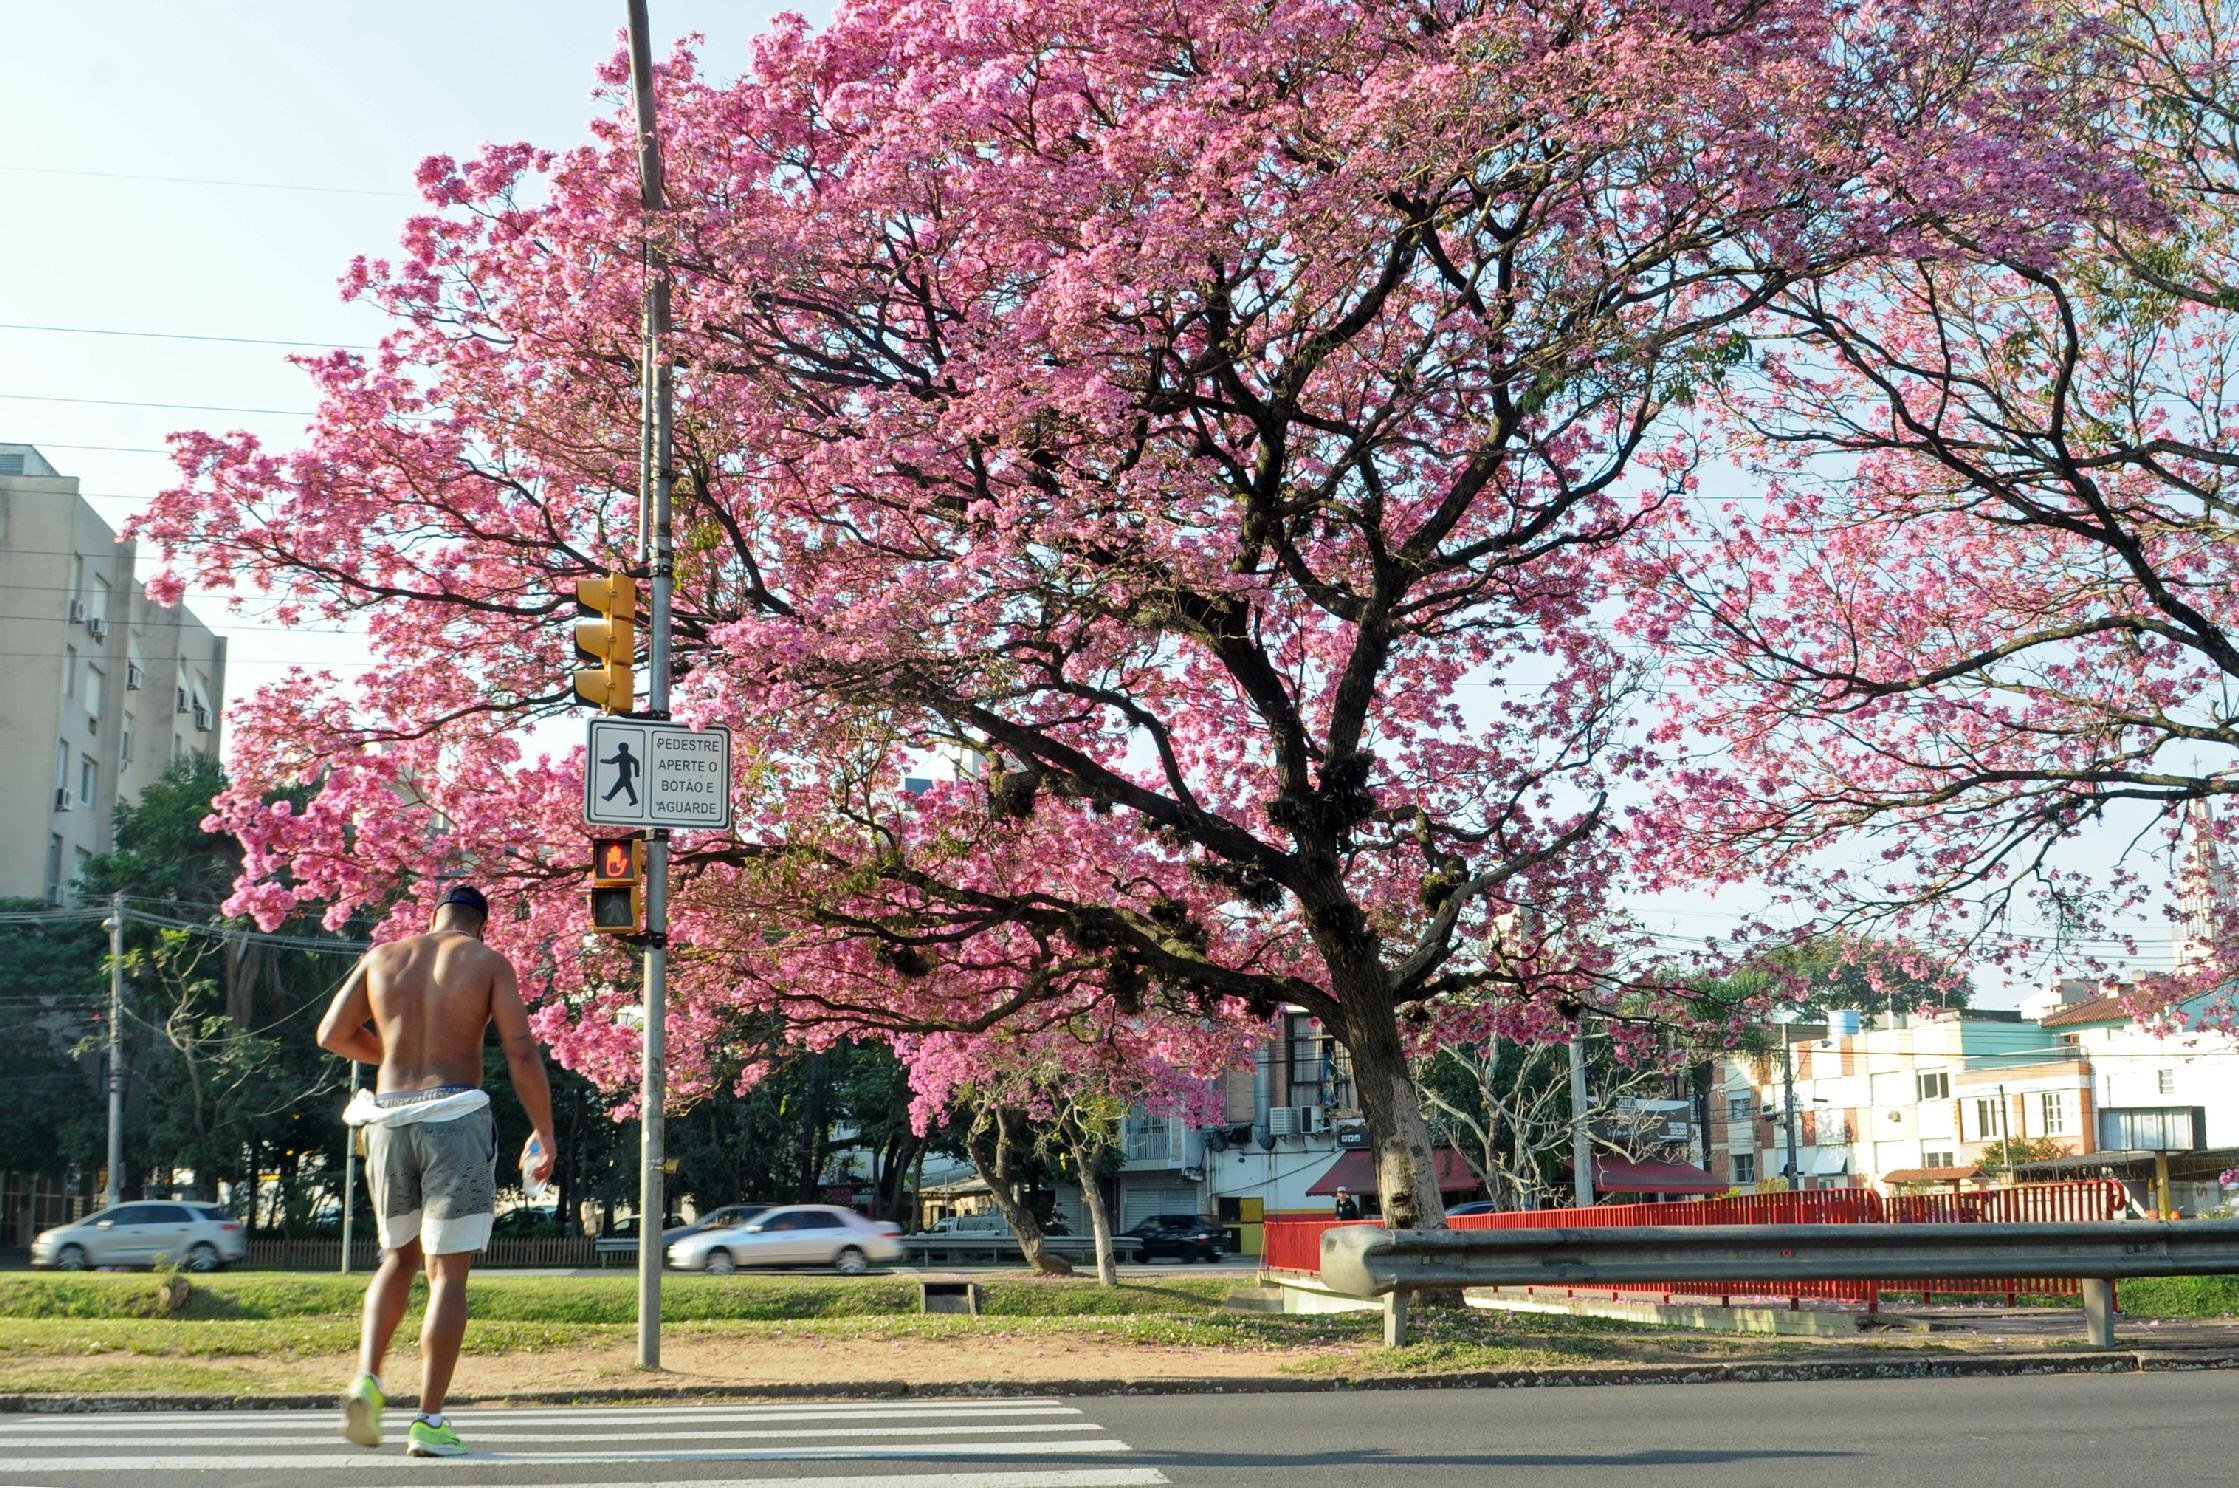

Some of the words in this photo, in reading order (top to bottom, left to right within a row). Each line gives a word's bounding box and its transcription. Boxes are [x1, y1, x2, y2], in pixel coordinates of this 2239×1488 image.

[657, 738, 719, 752] PEDESTRE
[658, 759, 705, 772] APERTE
[708, 761, 718, 773] O
[661, 778, 703, 793] BOTÃO
[706, 782, 714, 793] E
[656, 801, 717, 814] AGUARDE
